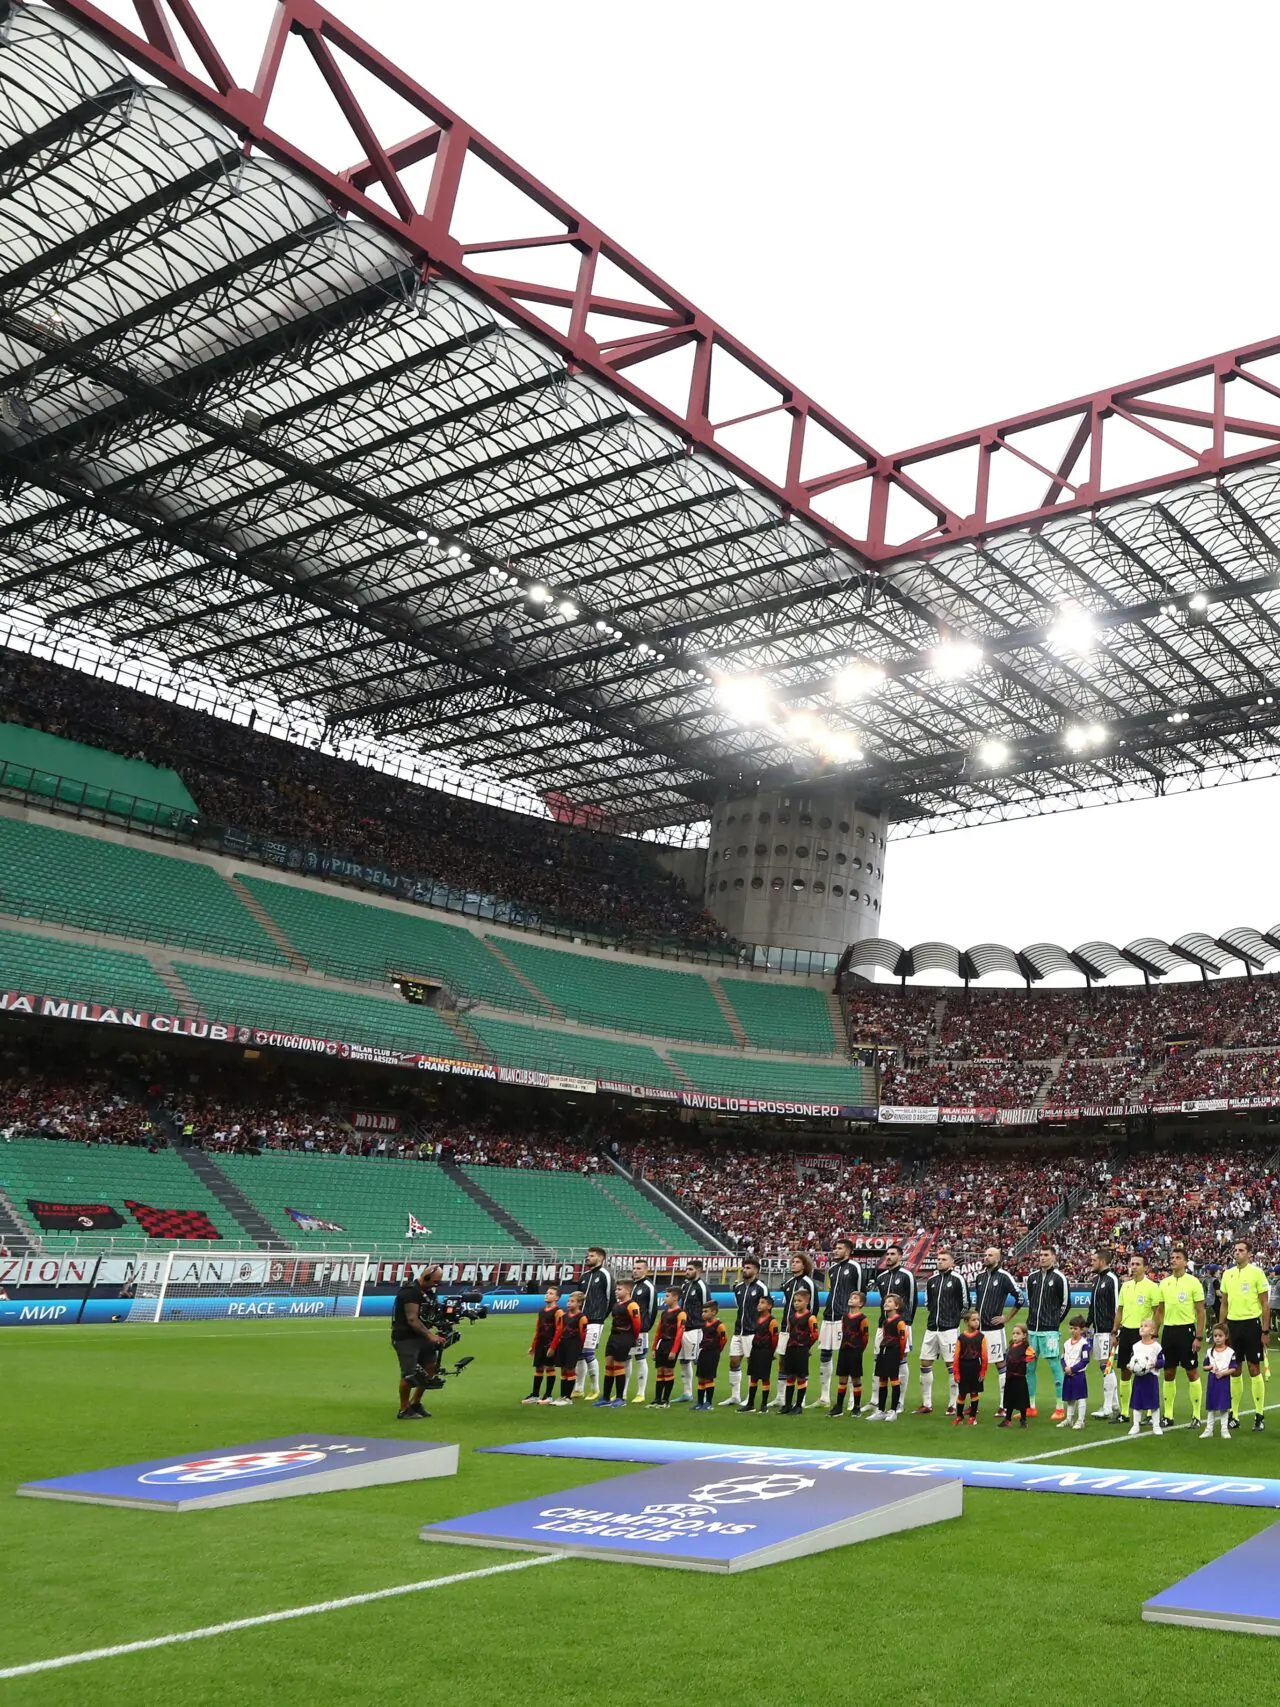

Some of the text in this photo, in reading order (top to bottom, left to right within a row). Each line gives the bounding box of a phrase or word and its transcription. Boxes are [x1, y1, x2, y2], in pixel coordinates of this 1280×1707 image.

[43, 1000, 141, 1027] MILAN
[151, 1017, 228, 1040] CLUB
[269, 1033, 325, 1053] CUGGIONO
[351, 1044, 391, 1057] MILAN CLUB
[351, 1051, 398, 1065] BUSTO ARSIZIO
[418, 1061, 496, 1080] CRANS MONTANA
[682, 1092, 839, 1116] NAVIGLIO ROSSONERO
[1253, 1096, 1271, 1104] CLUB
[1082, 1104, 1148, 1117] MILAN CLUB LATINA
[354, 1114, 396, 1130] MILAN
[124, 1260, 225, 1281] MILAN
[314, 1262, 574, 1282] FAMILY DAY AIMC
[228, 1302, 275, 1315] PEACE
[289, 1301, 324, 1314] МИР
[492, 1300, 520, 1310] МИР
[1074, 1295, 1091, 1305] PEA
[19, 1305, 67, 1320] МИР
[990, 1343, 1001, 1355] 27
[694, 1450, 949, 1478] PEACE
[1023, 1472, 1267, 1496] МИР
[538, 1507, 757, 1535] CHAMPIONS
[532, 1518, 688, 1542] LEAGUE
